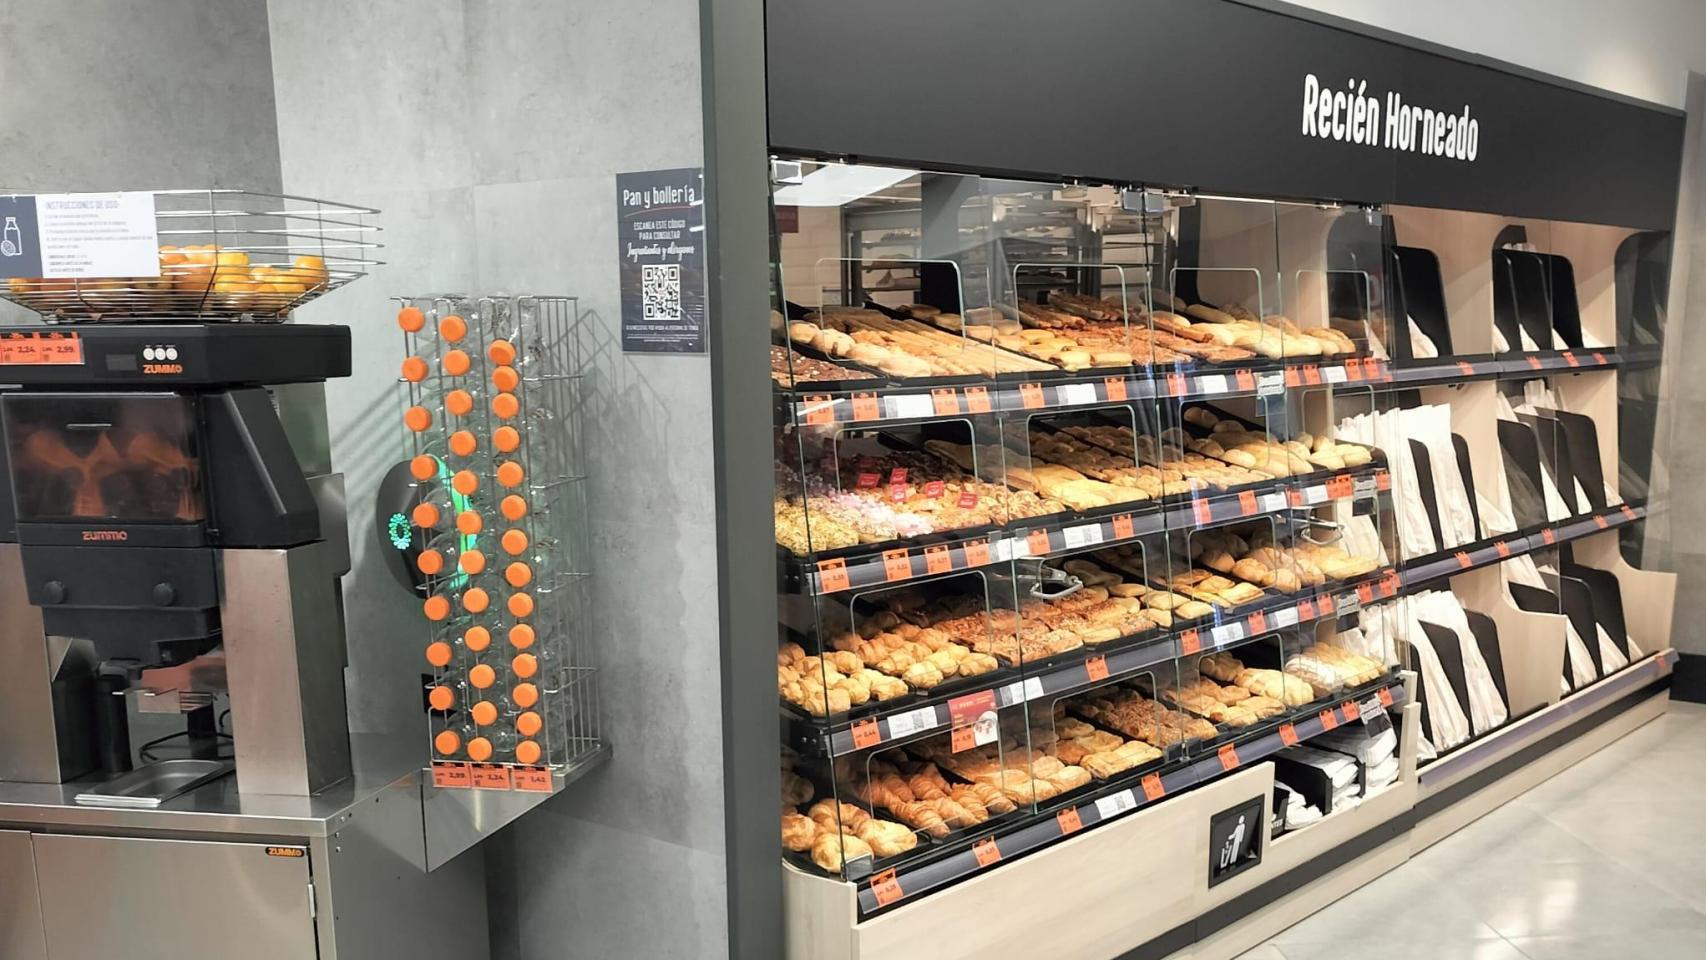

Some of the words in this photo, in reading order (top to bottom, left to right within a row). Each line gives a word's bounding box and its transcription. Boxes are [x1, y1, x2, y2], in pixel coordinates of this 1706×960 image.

[1302, 73, 1380, 146] Recién
[1384, 91, 1479, 162] Horneado
[623, 189, 642, 206] Pan
[643, 191, 651, 209] y
[652, 184, 695, 205] bollería
[633, 221, 655, 231] ESCANEA
[655, 220, 667, 230] ESTE
[638, 231, 653, 240] PARA
[653, 230, 681, 240] CONSULTAR
[143, 364, 183, 374] ZUMMO
[268, 847, 302, 857] ZUMMO
